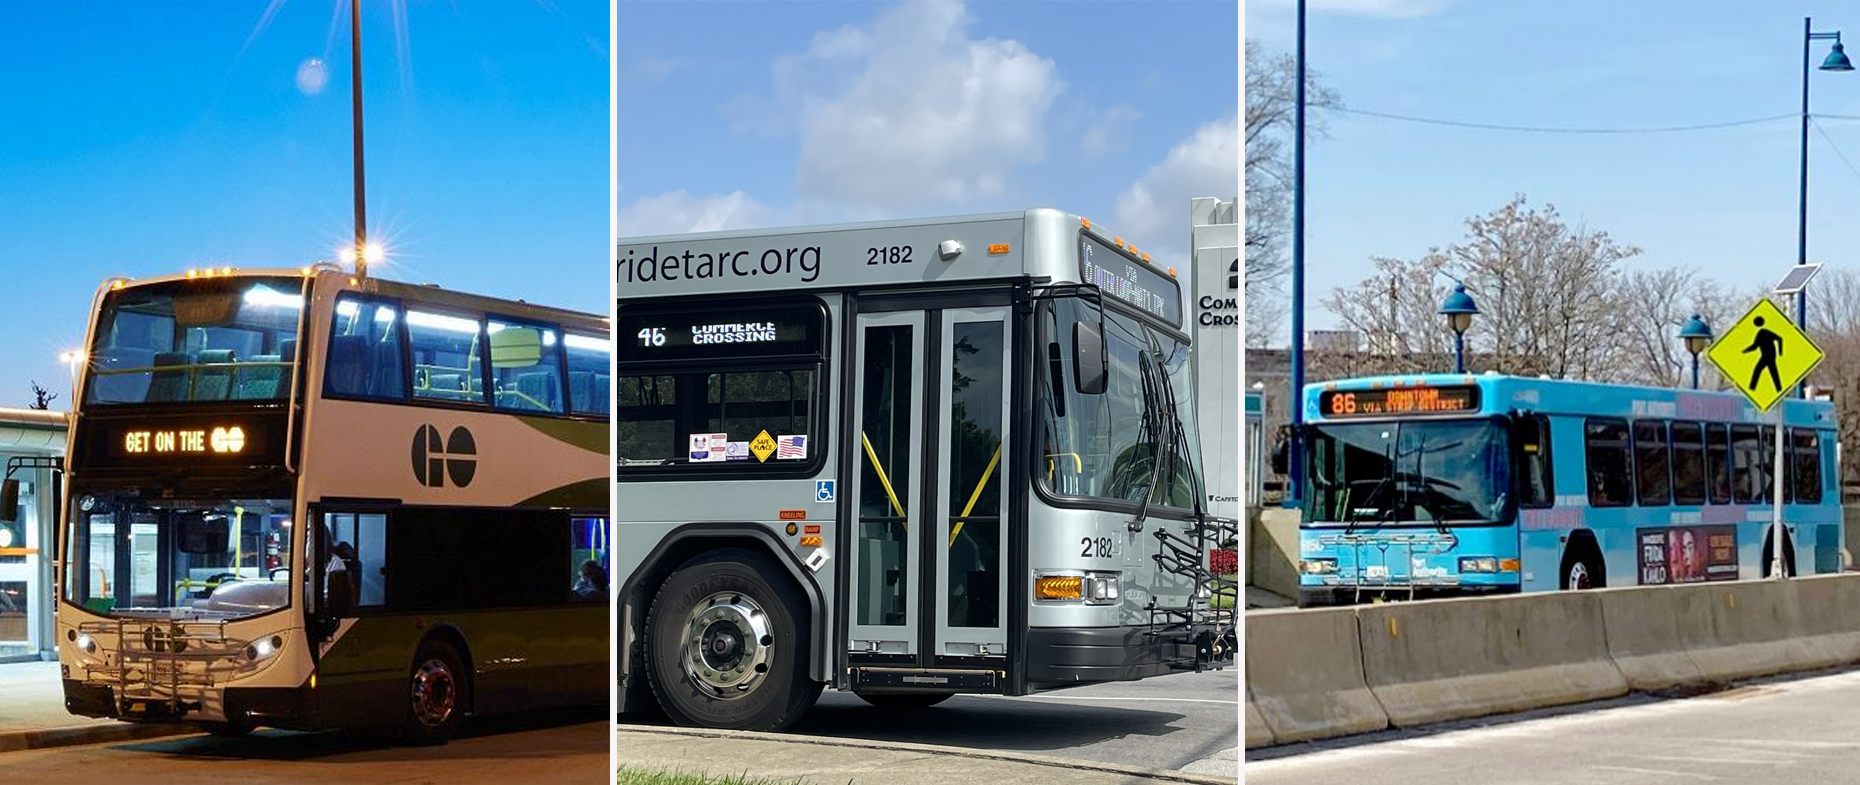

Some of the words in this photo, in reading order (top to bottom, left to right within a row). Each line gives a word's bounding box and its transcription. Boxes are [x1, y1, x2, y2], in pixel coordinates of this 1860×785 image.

[617, 245, 822, 283] ridetarc.org
[867, 245, 913, 266] 2182
[637, 327, 667, 347] 46
[692, 331, 777, 345] CROSSING
[1332, 393, 1356, 414] 86
[125, 431, 151, 452] GET
[155, 431, 175, 452] ON
[179, 431, 205, 452] THE
[411, 423, 477, 488] GO
[1081, 537, 1112, 558] 2182
